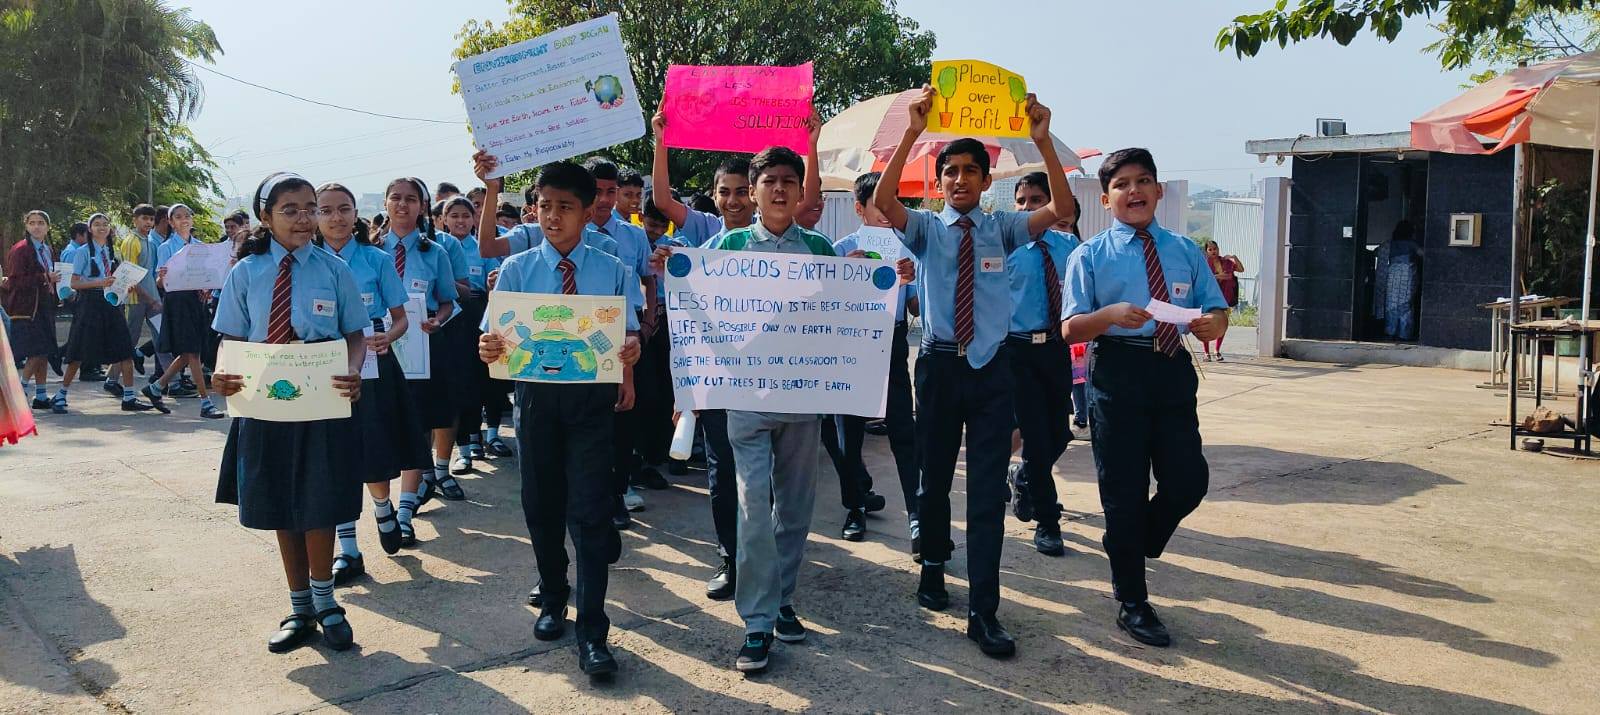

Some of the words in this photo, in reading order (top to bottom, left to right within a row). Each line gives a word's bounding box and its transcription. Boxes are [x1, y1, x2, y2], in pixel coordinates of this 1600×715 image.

[960, 64, 1005, 85] Planet
[730, 96, 747, 107] IS
[969, 92, 996, 103] over
[734, 115, 809, 129] SOLUTION
[960, 106, 1001, 130] Profit
[701, 255, 781, 278] WORLDS
[788, 261, 836, 280] EARTH
[844, 263, 872, 282] DAY
[668, 291, 708, 310] LESS
[714, 295, 783, 313] POLLUTION
[788, 301, 799, 312] IS
[801, 301, 817, 311] THE
[821, 301, 841, 312] BEST
[670, 320, 697, 336] LIFE
[702, 321, 713, 333] IS
[719, 321, 756, 333] POSSIBLE
[802, 324, 832, 335] EARTH
[837, 326, 869, 338] PROTECT
[872, 329, 884, 339] IT
[672, 336, 696, 349] FROM
[701, 334, 744, 345] POLLUTION
[673, 356, 692, 368] SAVE
[695, 356, 711, 366] THE
[715, 356, 741, 366] EARTH
[746, 356, 761, 366] ITS
[768, 356, 784, 365] OUR
[789, 355, 837, 366] CLASSROOM
[841, 356, 857, 365] TOO
[704, 376, 723, 387] CUT
[728, 377, 754, 388] TREES
[770, 379, 778, 389] IS
[825, 381, 851, 391] EARTH
